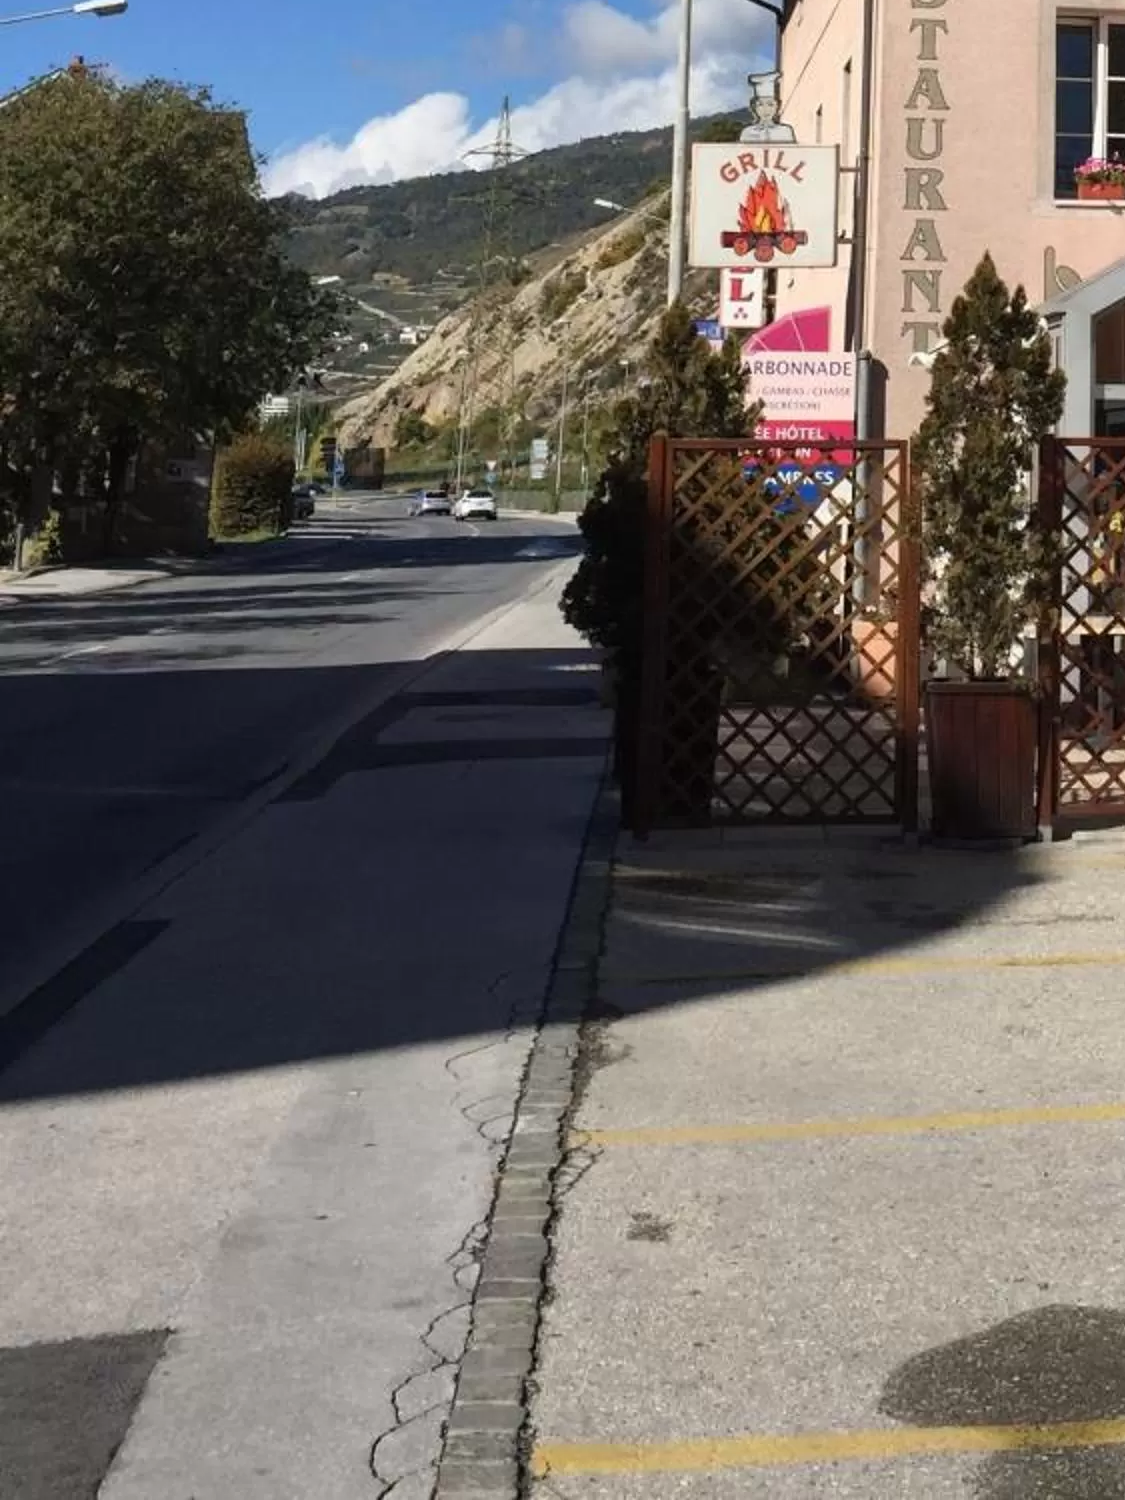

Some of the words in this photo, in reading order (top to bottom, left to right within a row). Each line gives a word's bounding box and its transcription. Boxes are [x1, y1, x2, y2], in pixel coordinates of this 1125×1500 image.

[720, 149, 806, 182] GRILL
[743, 361, 852, 376] ARBONNADE
[775, 424, 824, 440] HÔTEL
